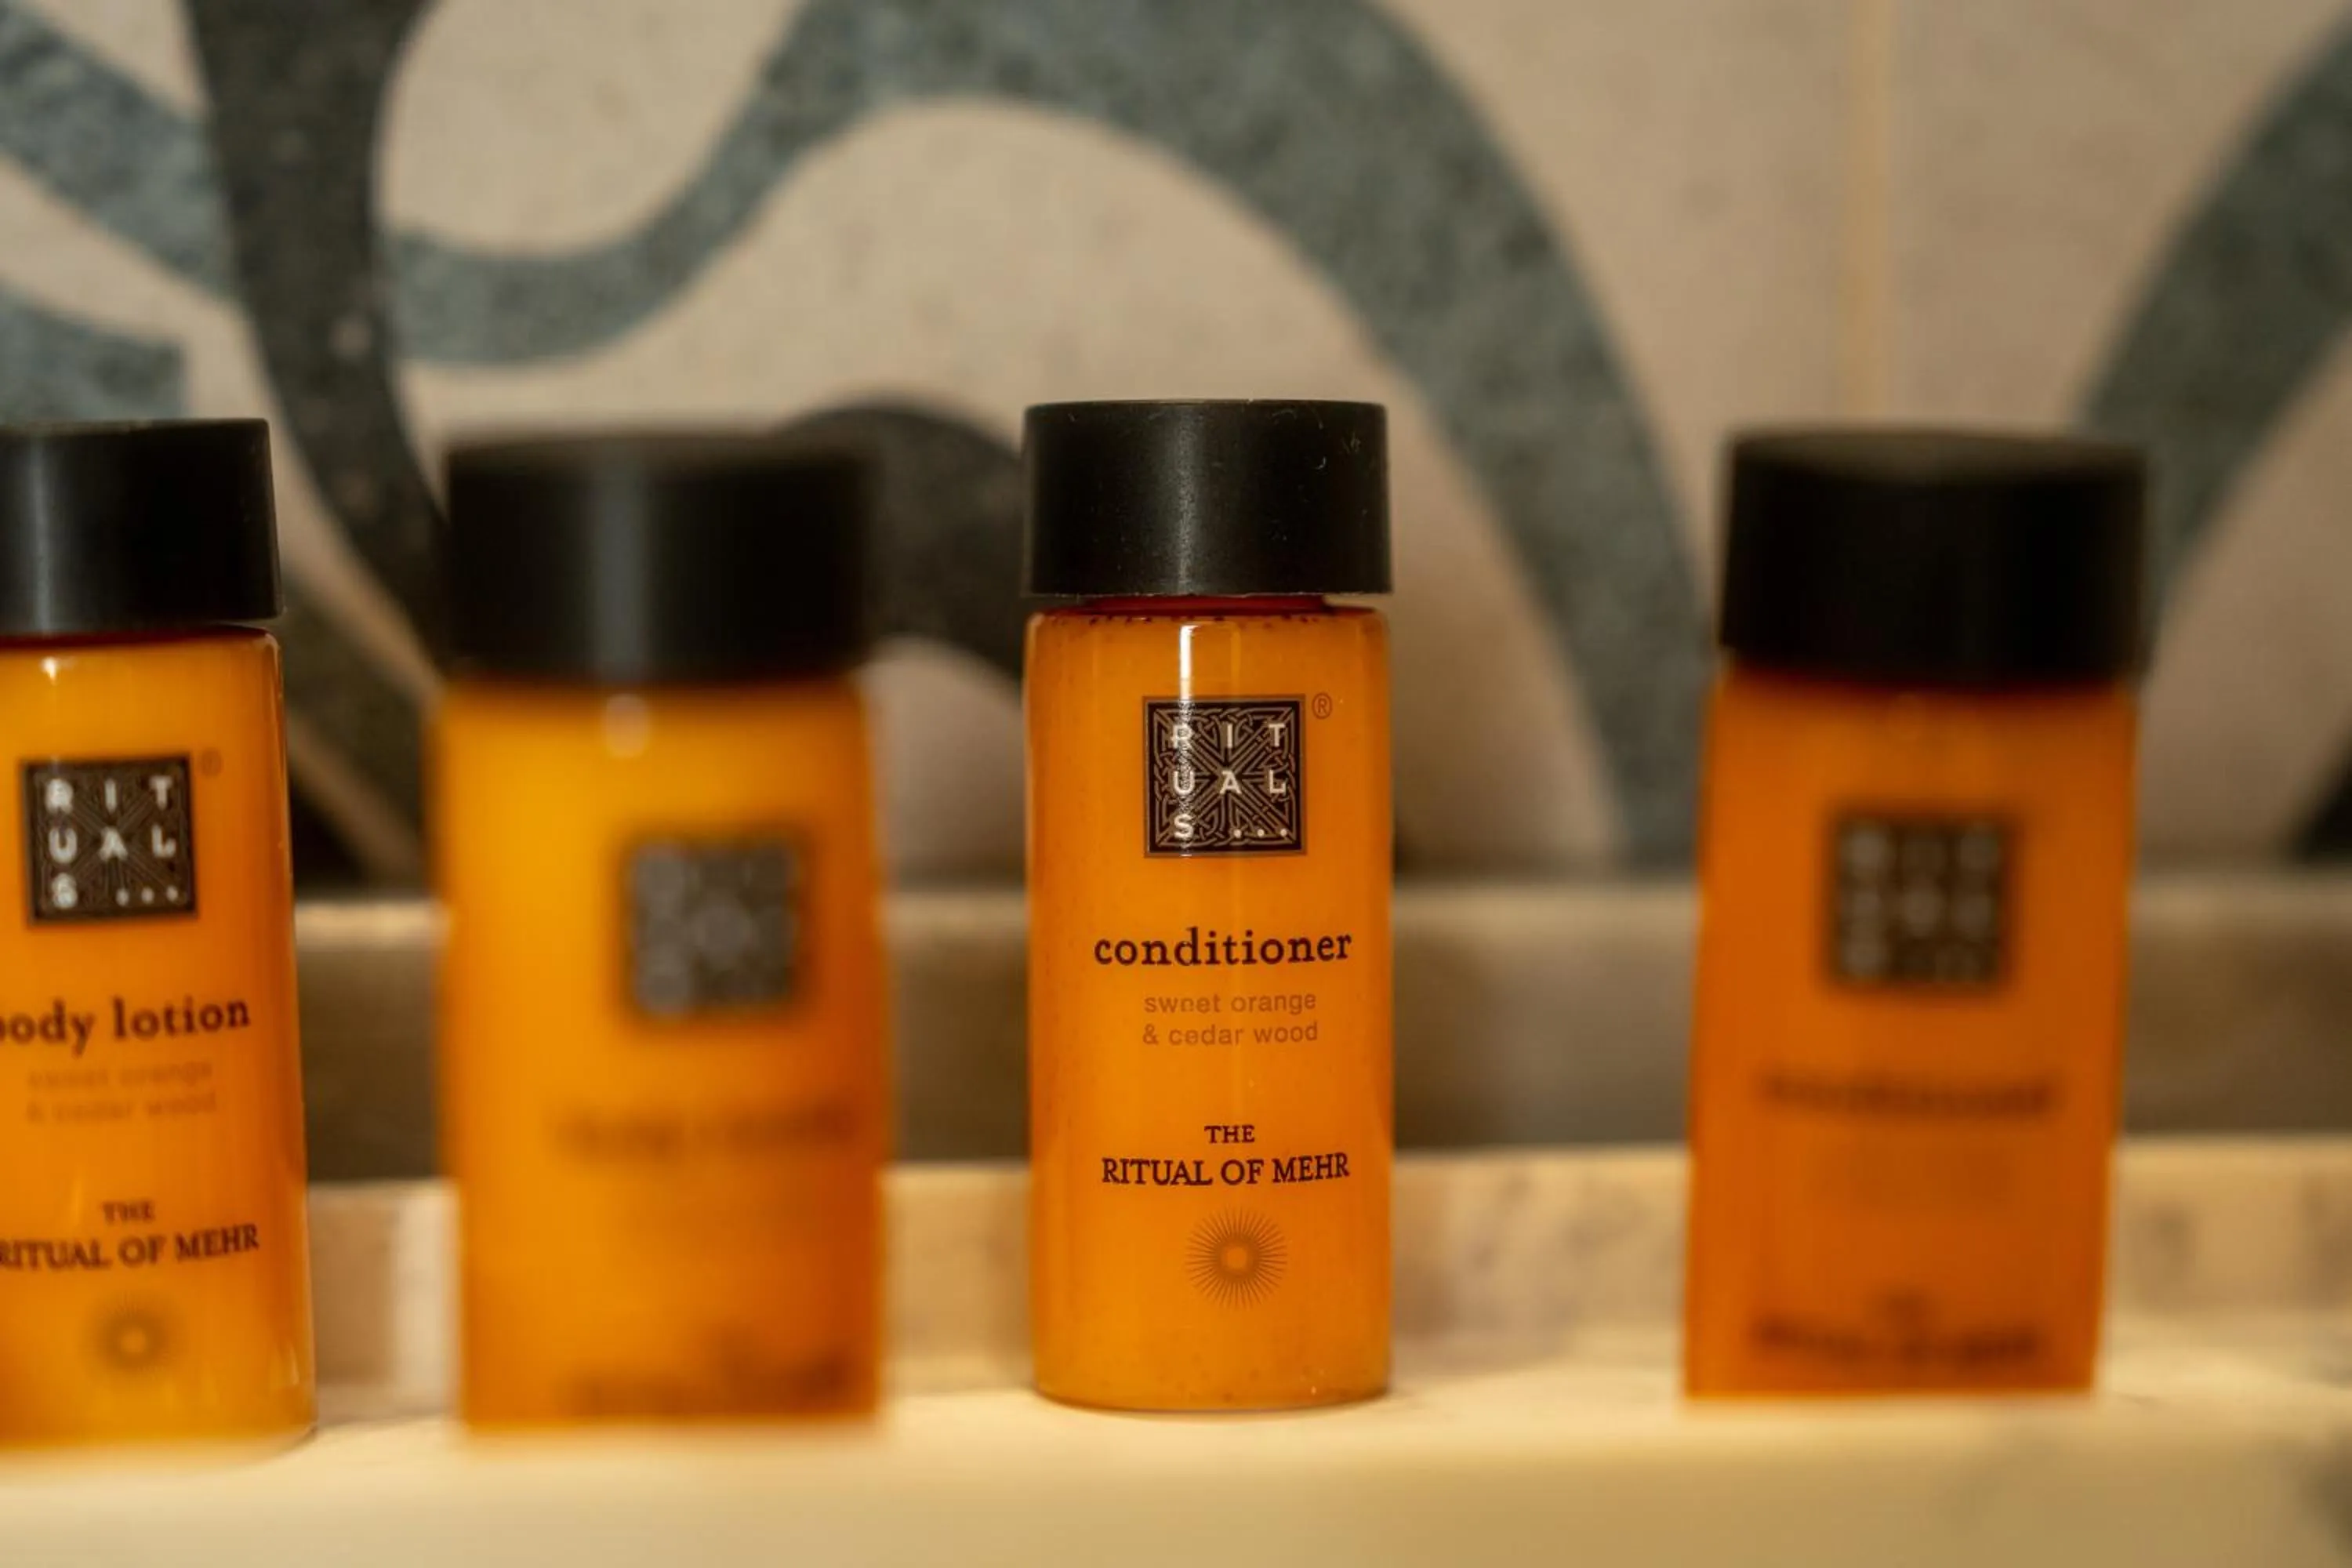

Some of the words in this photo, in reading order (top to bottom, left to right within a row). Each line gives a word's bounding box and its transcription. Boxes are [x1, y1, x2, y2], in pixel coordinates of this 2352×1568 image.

[1094, 925, 1352, 967] conditioner
[1230, 993, 1316, 1015] orange
[0, 995, 95, 1058] ody
[113, 994, 251, 1041] lotion
[1142, 1023, 1160, 1045] &
[1168, 1023, 1244, 1046] cedar
[1254, 1021, 1318, 1044] wood
[1203, 1123, 1256, 1144] THE
[1101, 1156, 1214, 1186] RITUAL
[1220, 1159, 1265, 1185] OF
[1271, 1152, 1351, 1183] MEHR
[103, 1200, 155, 1224] THE
[117, 1234, 166, 1268] OF
[174, 1223, 260, 1262] MEHR
